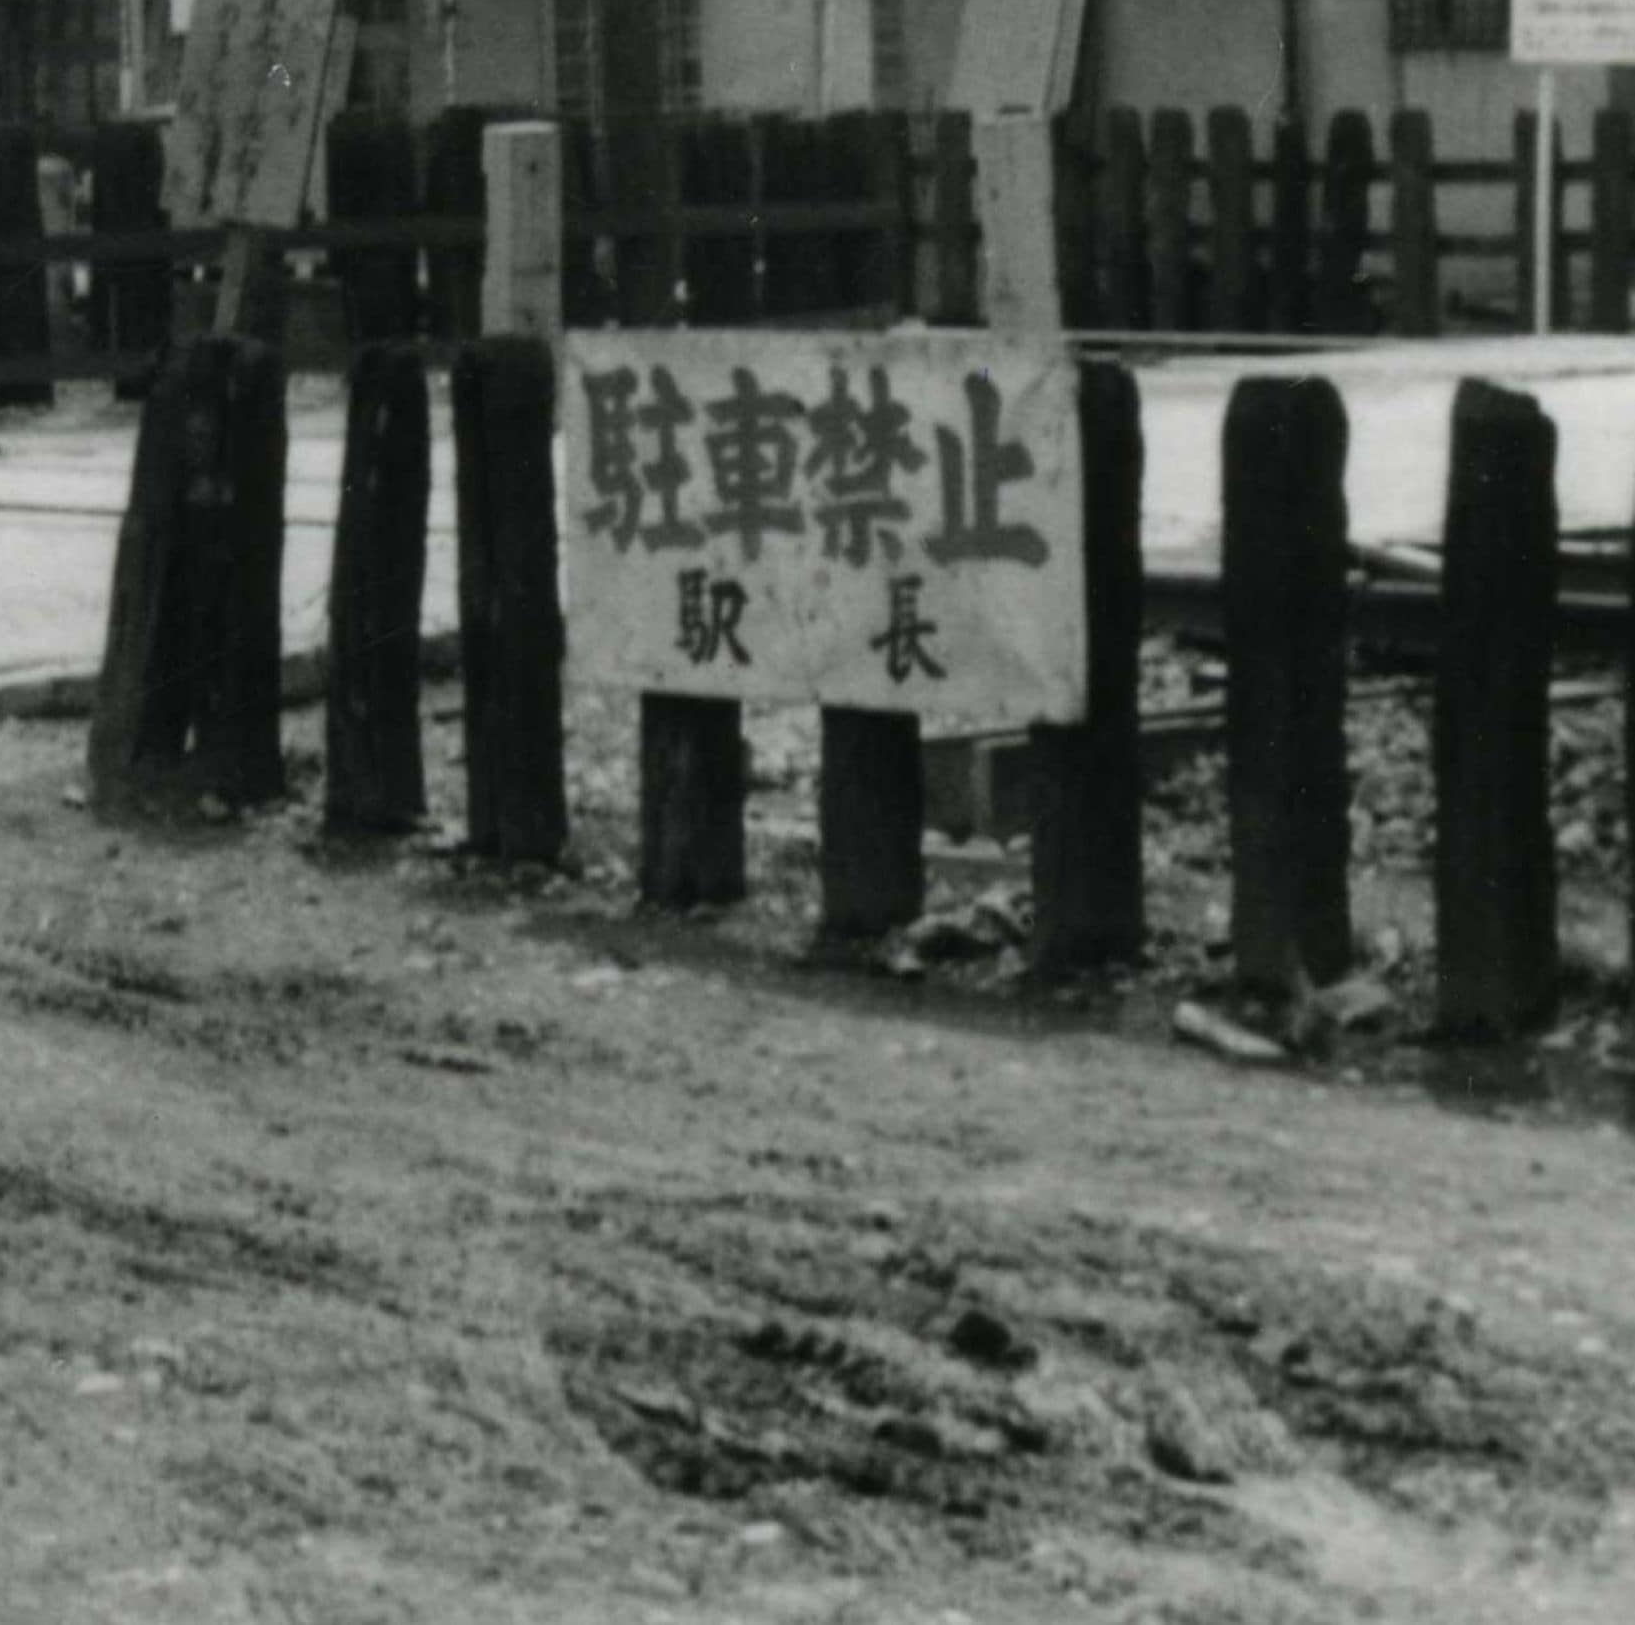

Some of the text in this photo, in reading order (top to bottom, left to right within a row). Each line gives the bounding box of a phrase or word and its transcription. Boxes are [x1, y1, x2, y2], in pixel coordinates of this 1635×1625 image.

[581, 366, 1051, 570] 駐車禁止
[675, 569, 947, 684] 駅長
